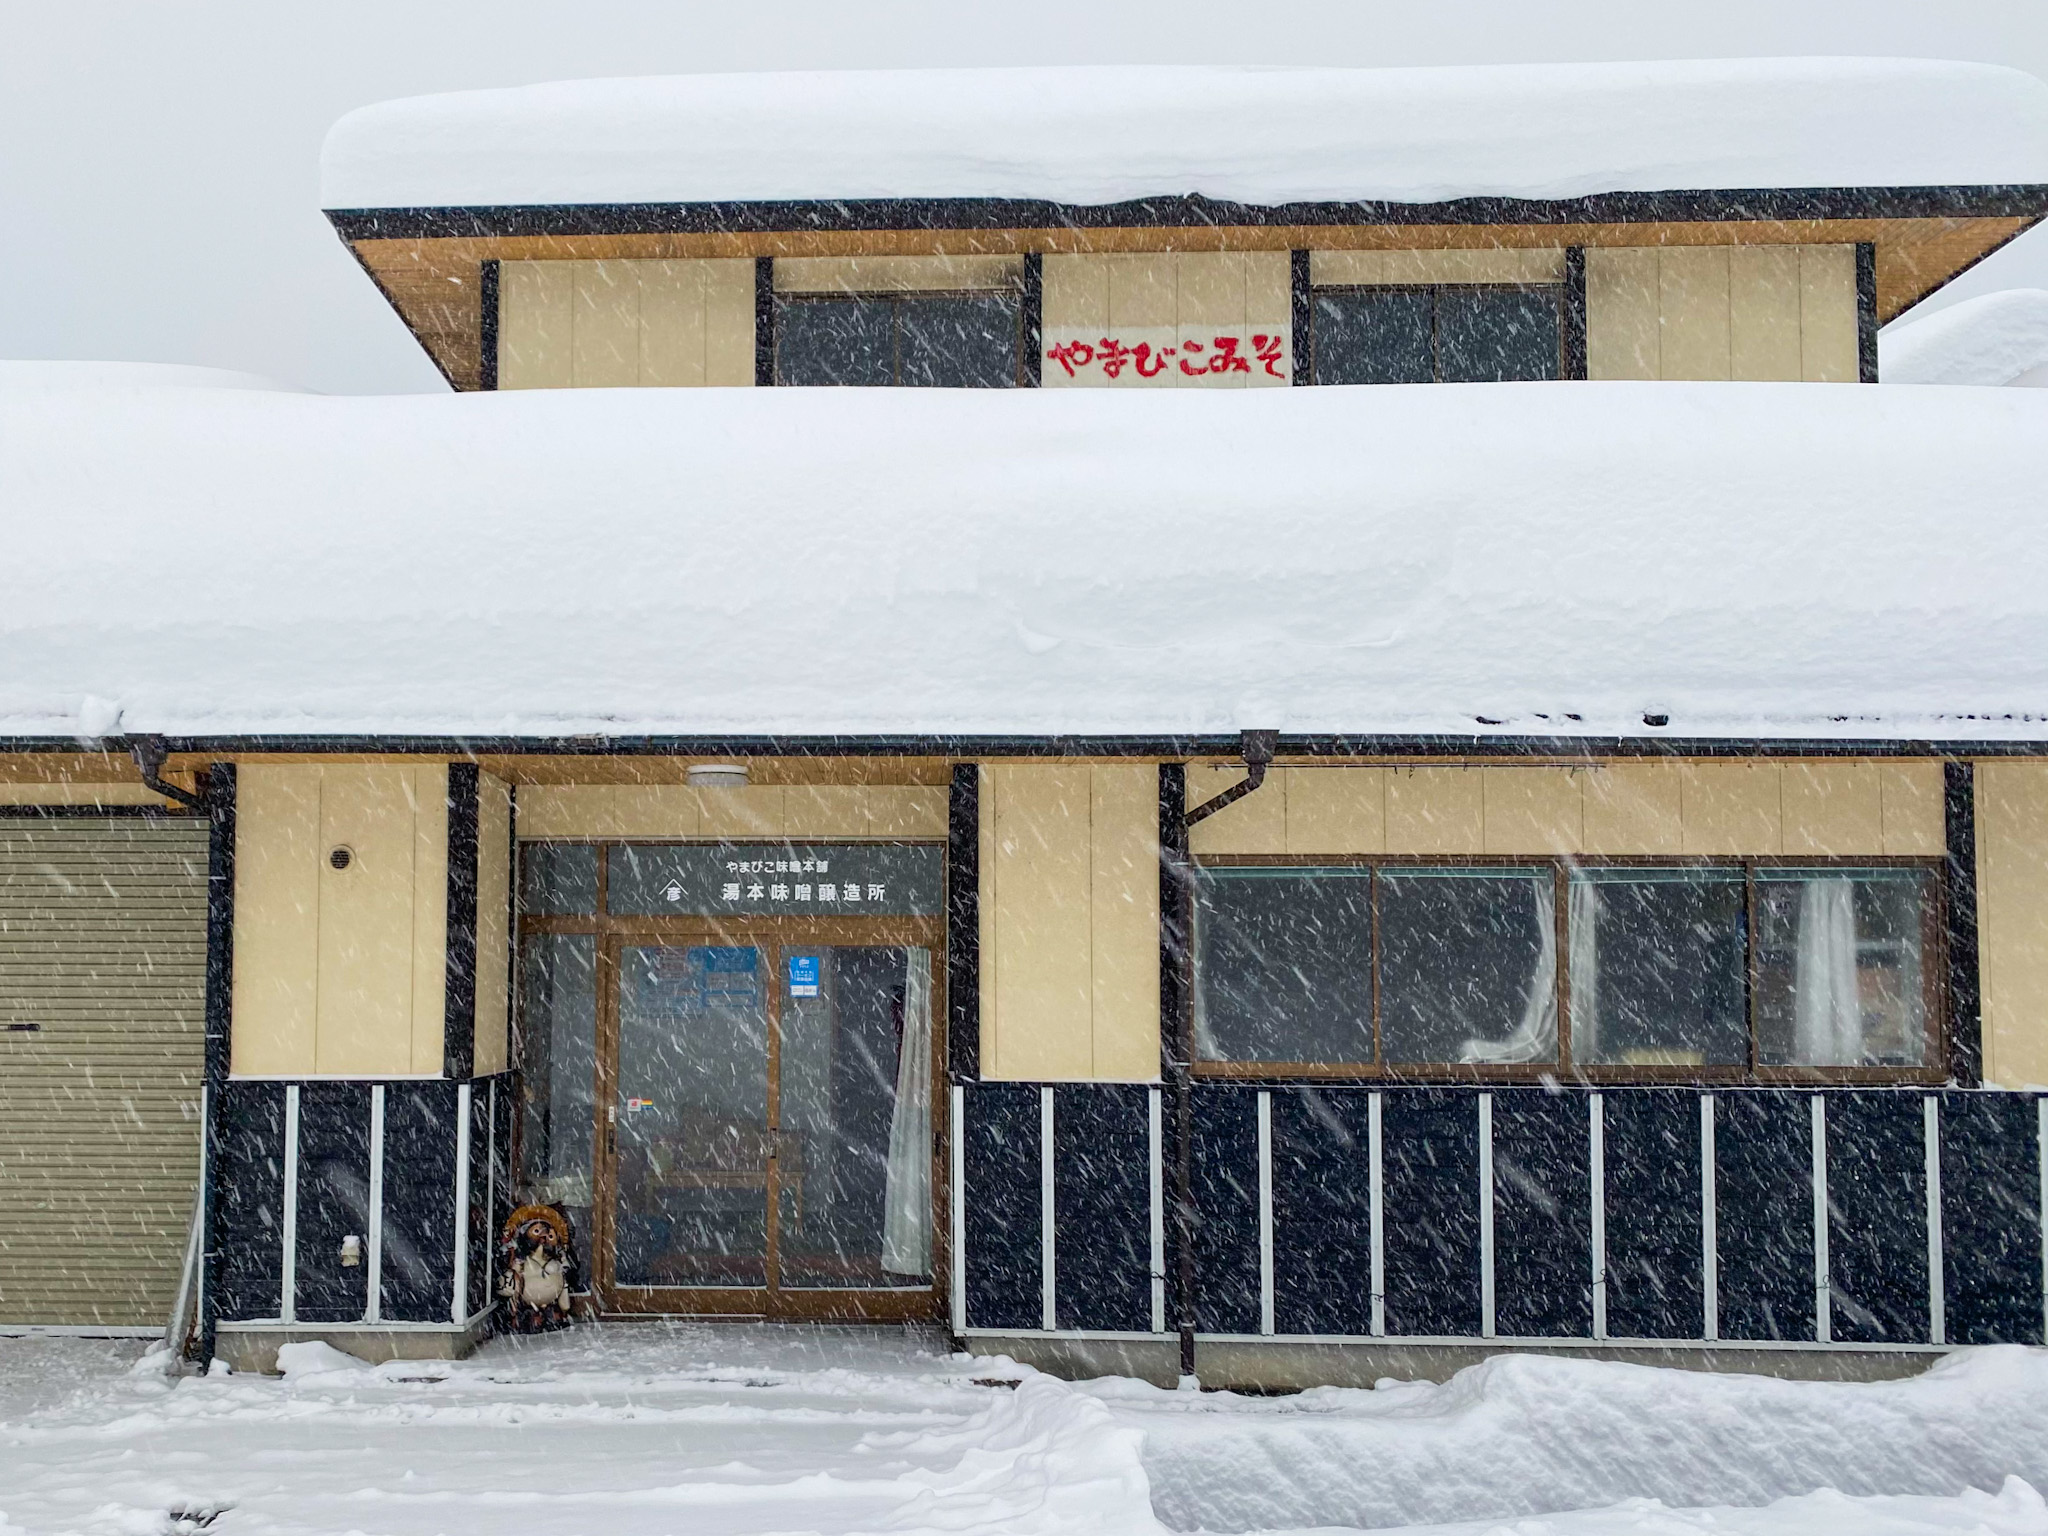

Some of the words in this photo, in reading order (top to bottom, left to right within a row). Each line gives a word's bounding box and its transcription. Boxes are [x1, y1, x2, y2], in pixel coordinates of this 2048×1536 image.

[1047, 334, 1286, 379] やまびこみそ
